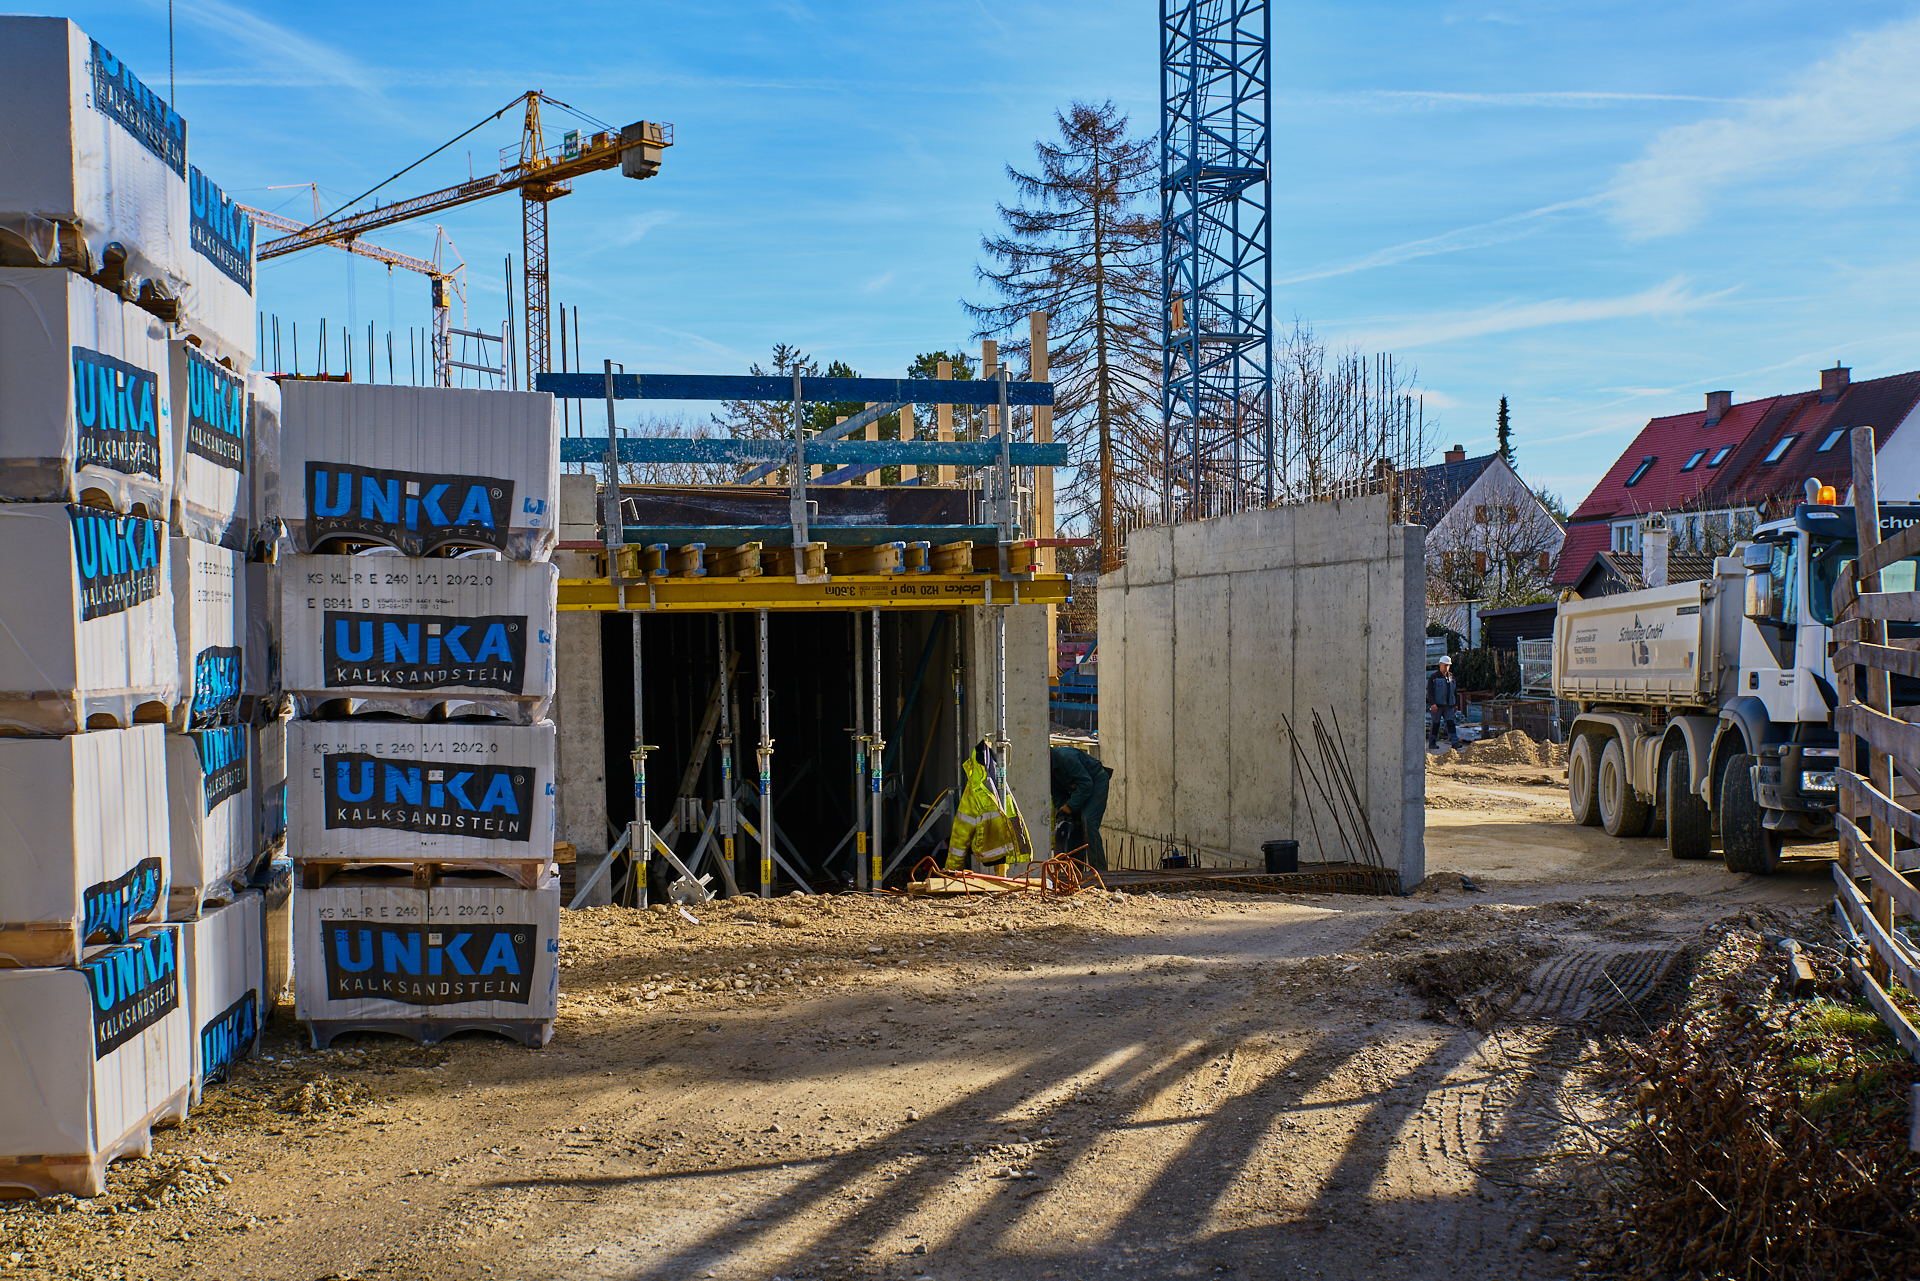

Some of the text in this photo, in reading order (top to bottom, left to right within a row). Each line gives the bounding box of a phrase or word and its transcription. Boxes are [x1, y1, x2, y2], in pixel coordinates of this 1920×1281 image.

[1174, 302, 1180, 328] 1
[191, 424, 242, 463] KALKSANDSTEIN
[80, 436, 157, 467] KALKSANDSTEIN
[308, 573, 493, 586] KS XL-R E 240 1/1 20/2.0
[83, 576, 157, 608] KALKSANDSTEIN
[825, 586, 856, 596] 3.60m
[891, 585, 898, 596] P
[900, 583, 916, 595] top
[920, 585, 939, 595] H20
[945, 585, 981, 595] doka
[307, 598, 316, 609] E
[337, 667, 513, 684] KALKSANDSTEIN
[313, 743, 329, 754] KS
[376, 743, 384, 754] E
[391, 743, 415, 754] 240
[423, 743, 444, 753] 1/1
[453, 743, 498, 753] 20/2.0
[338, 807, 520, 833] KALKSANDSTEIN
[318, 905, 504, 918] KS XL-R E 240 1/1 20/2.0
[339, 977, 521, 996] KALKSANDSTEIN
[100, 980, 177, 1042] KALKSANDSTEIN
